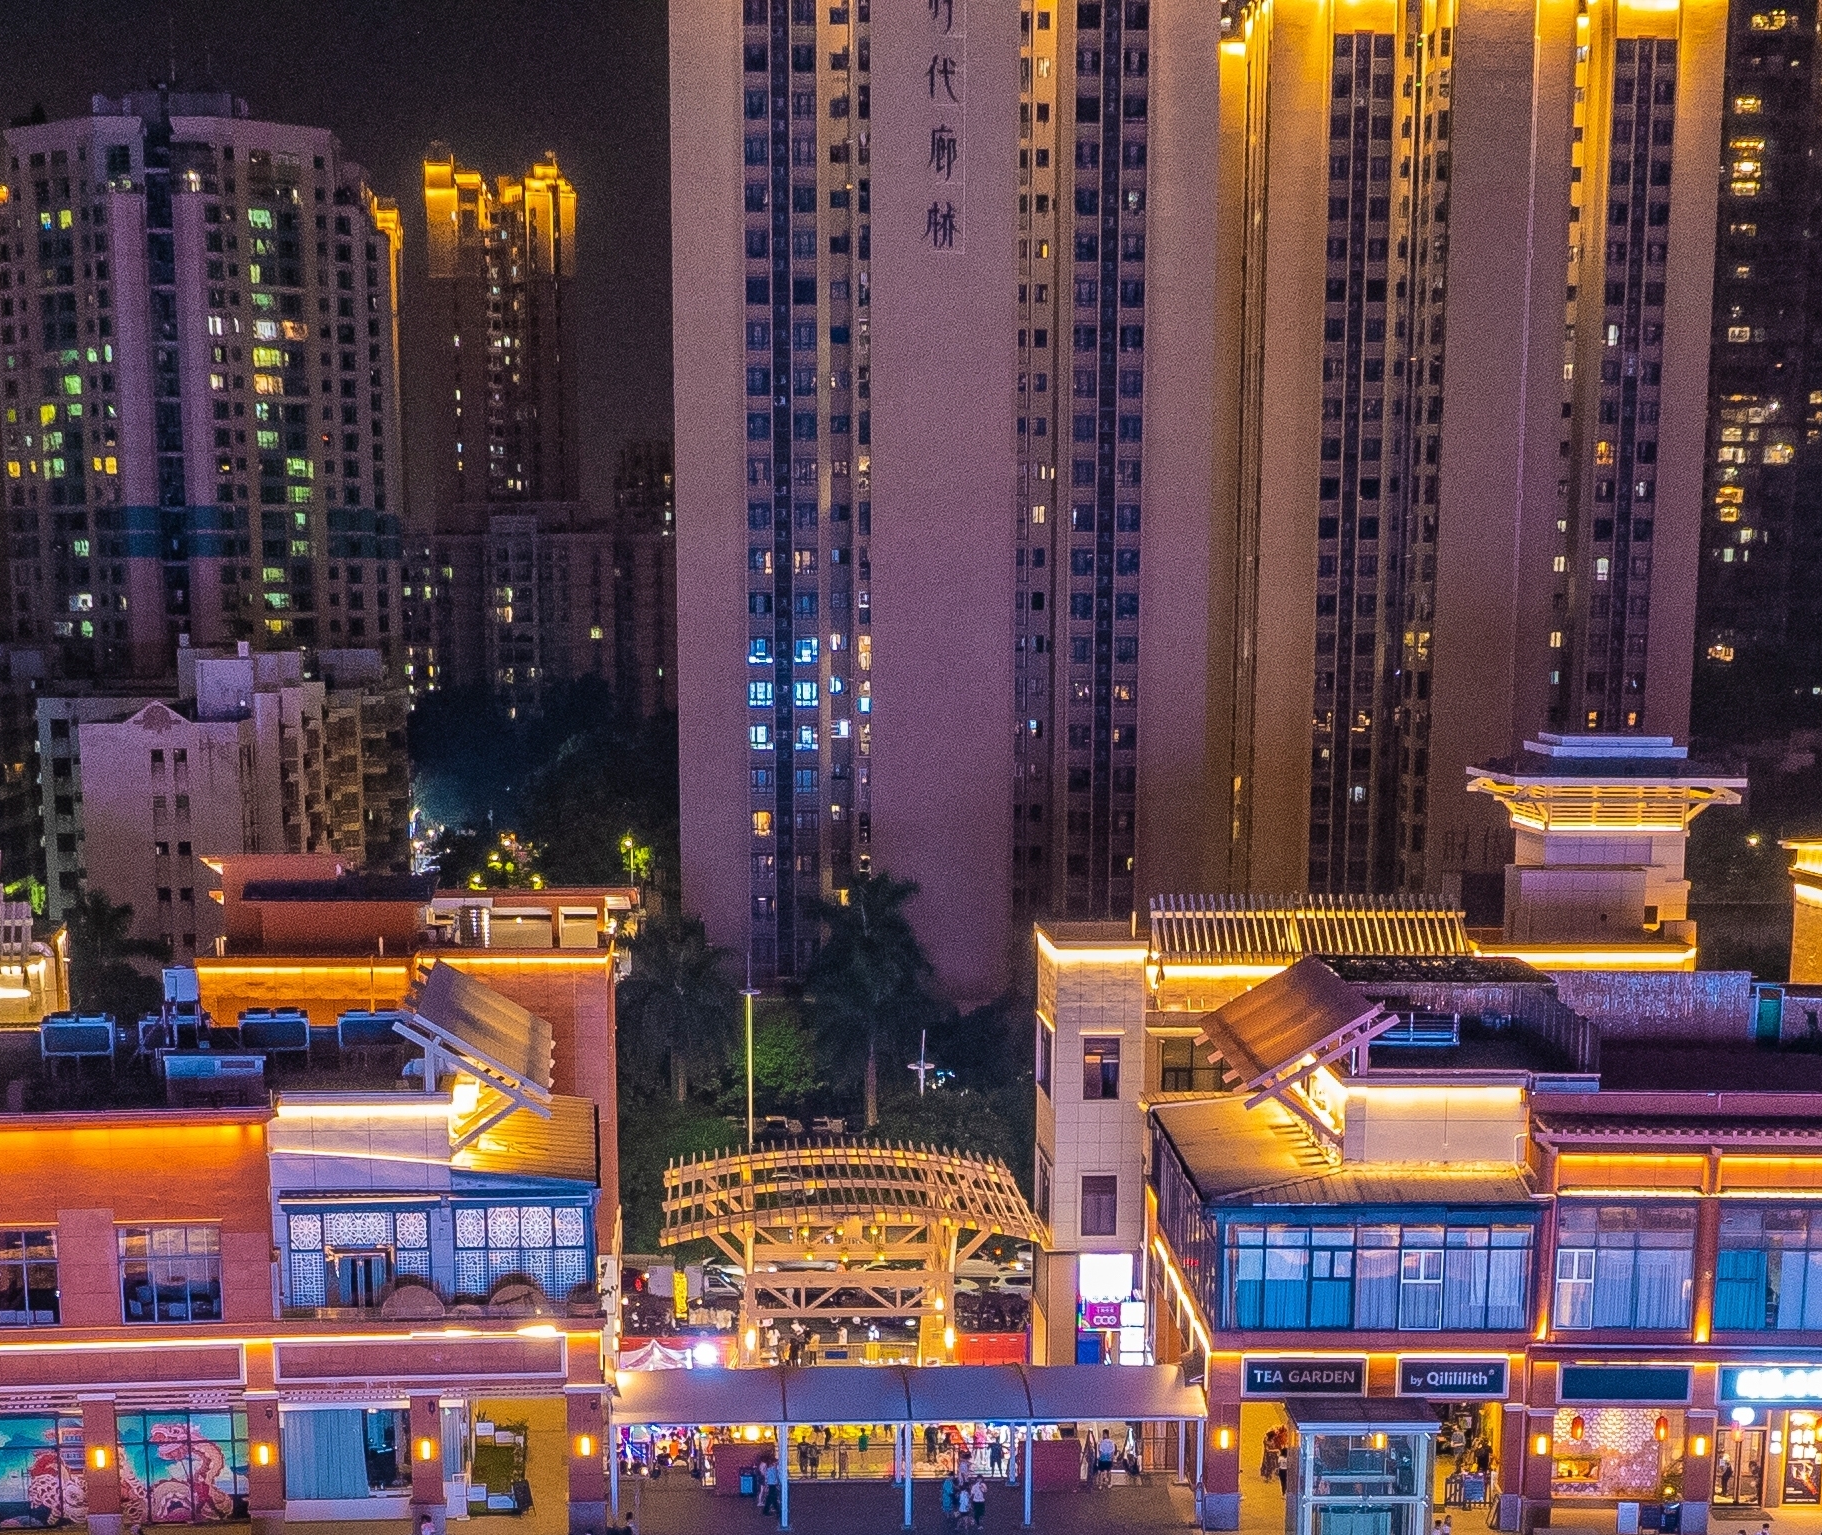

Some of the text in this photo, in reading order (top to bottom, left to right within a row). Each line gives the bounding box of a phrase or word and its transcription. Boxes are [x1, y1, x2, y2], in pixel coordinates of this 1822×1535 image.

[1253, 1369, 1355, 1384] TEA GARDEN
[1410, 1374, 1423, 1387] by
